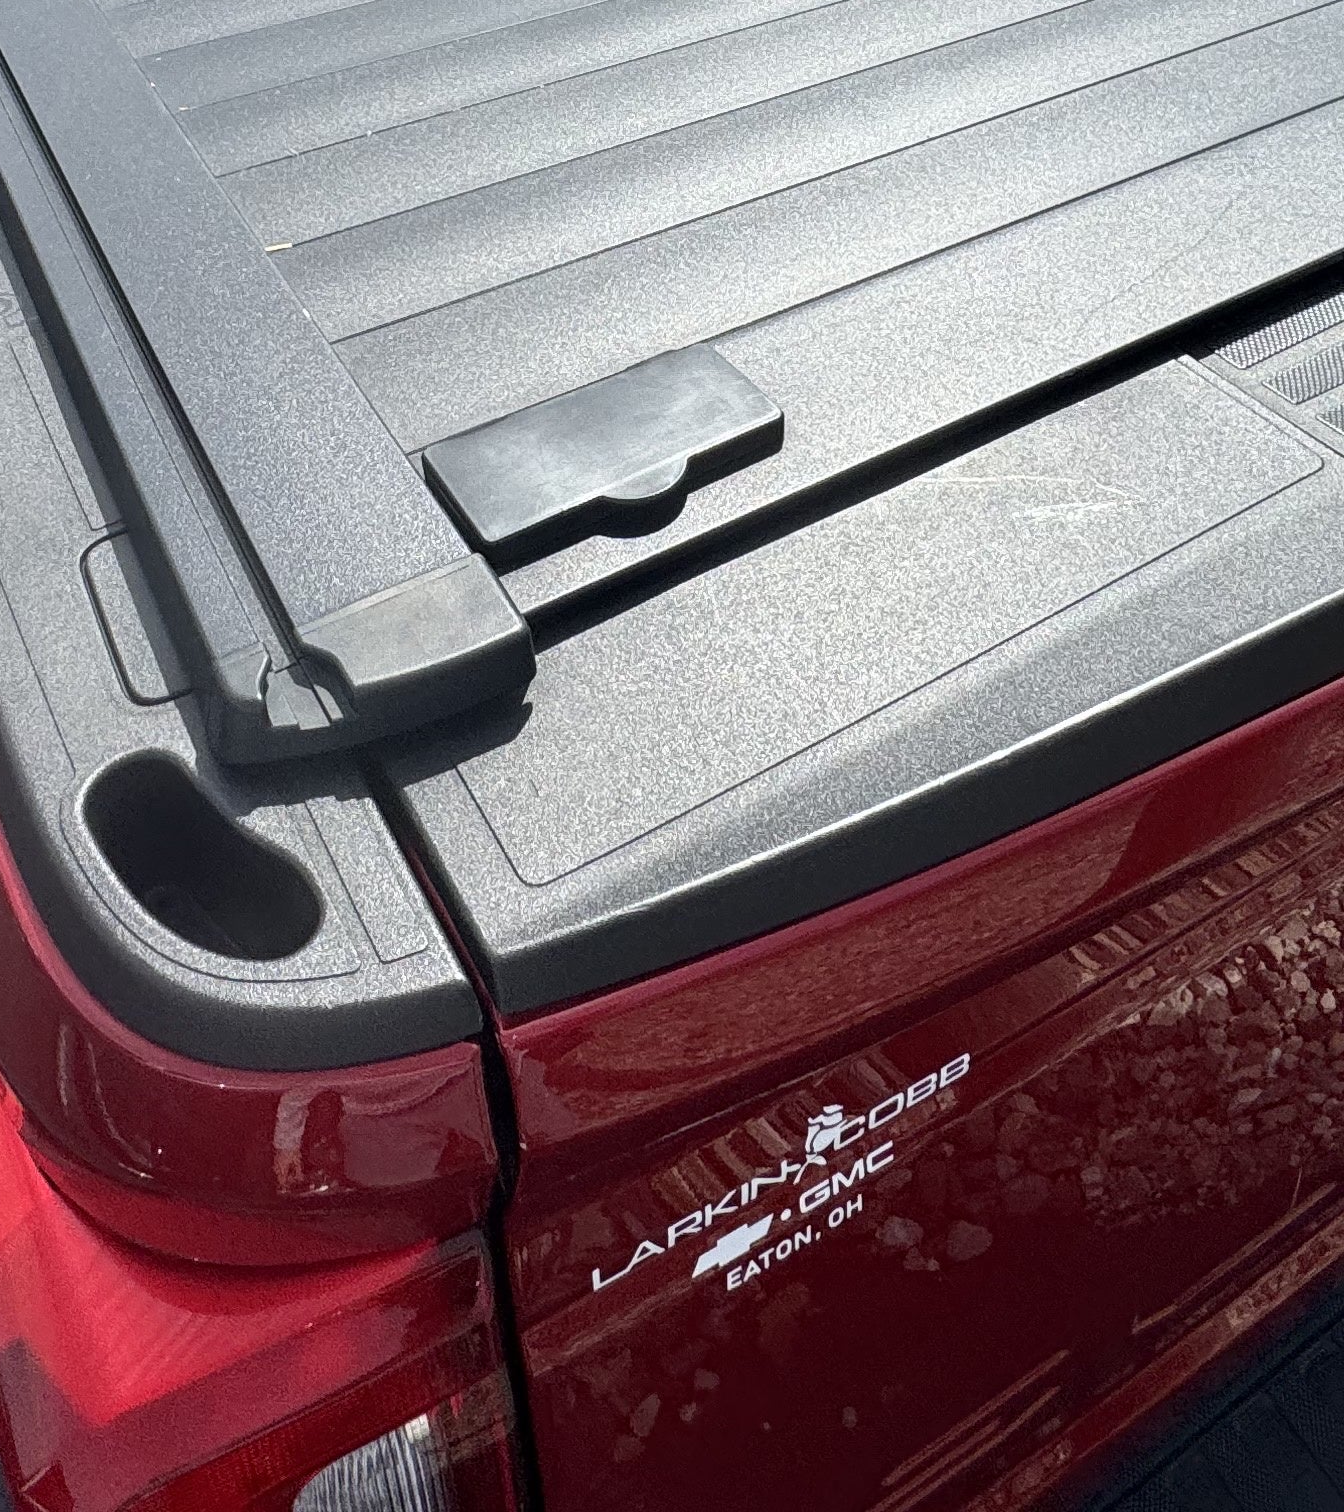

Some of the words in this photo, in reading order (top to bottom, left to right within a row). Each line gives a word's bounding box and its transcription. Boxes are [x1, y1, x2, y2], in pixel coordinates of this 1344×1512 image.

[591, 1159, 802, 1292] LARKIN
[832, 1052, 971, 1150] COBB
[798, 1140, 895, 1215] GMC
[726, 1225, 822, 1291] EATON,
[828, 1193, 864, 1228] OH
